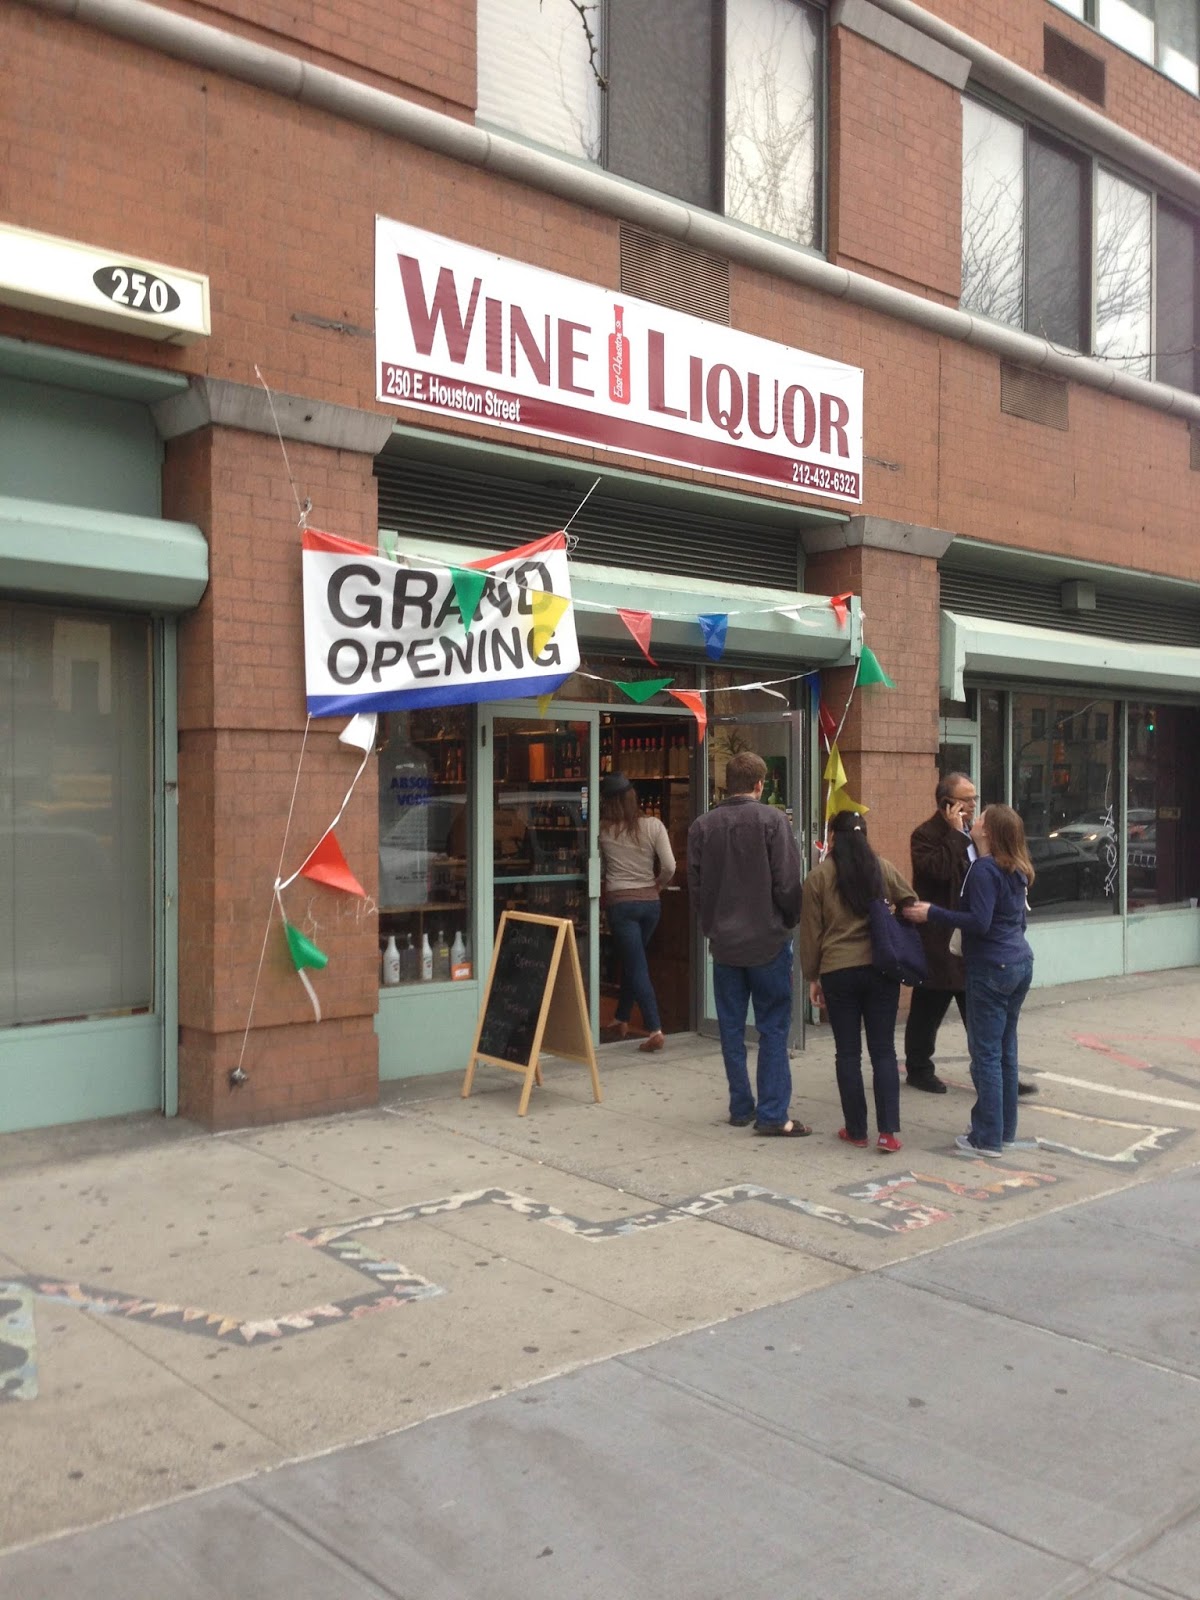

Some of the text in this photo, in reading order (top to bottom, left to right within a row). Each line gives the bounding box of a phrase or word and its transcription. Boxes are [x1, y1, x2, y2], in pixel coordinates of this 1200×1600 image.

[111, 268, 169, 313] 250
[397, 253, 850, 458] WINE LIQUOR
[386, 367, 521, 422] 250 E. Houston Street
[792, 463, 856, 495] 212-432-6322
[327, 561, 553, 629] GRAND
[327, 626, 561, 685] OPENING
